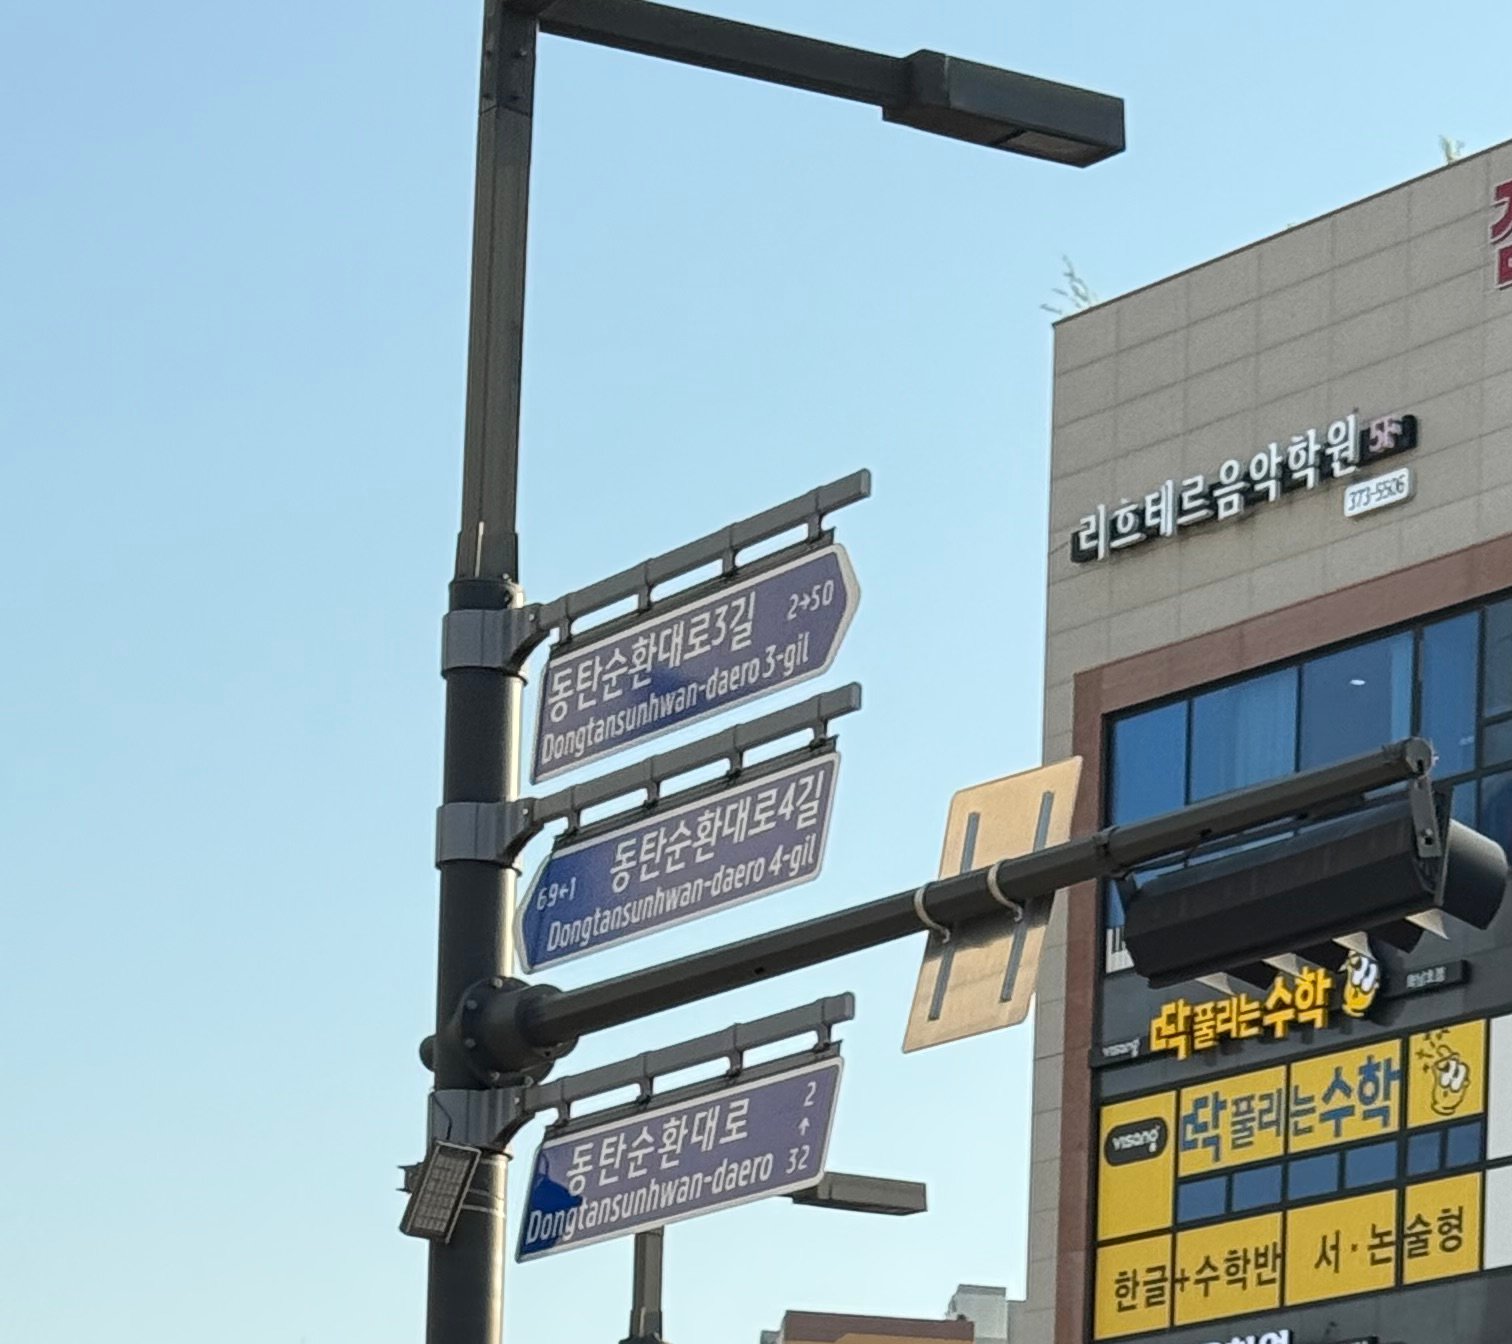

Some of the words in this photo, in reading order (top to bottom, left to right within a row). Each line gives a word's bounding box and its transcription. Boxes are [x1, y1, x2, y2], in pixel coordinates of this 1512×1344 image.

[1079, 414, 1360, 561] 리흐테르음악학원
[1368, 414, 1403, 453] 5F
[541, 660, 761, 766] Dongtansunhwan-daero
[762, 632, 810, 678] 3-gil
[549, 591, 757, 723] 동탄순환대로3길
[811, 579, 835, 611] 50
[610, 770, 825, 893] 동탄순환대로4길
[547, 860, 764, 951] Dongtansunhwan-daero
[768, 832, 816, 878] 4-gil
[566, 1098, 751, 1198] 동탄순환대로
[803, 1082, 817, 1108] 2
[526, 1151, 774, 1245] Dongtansunhwan-daero
[785, 1145, 809, 1175] 32
